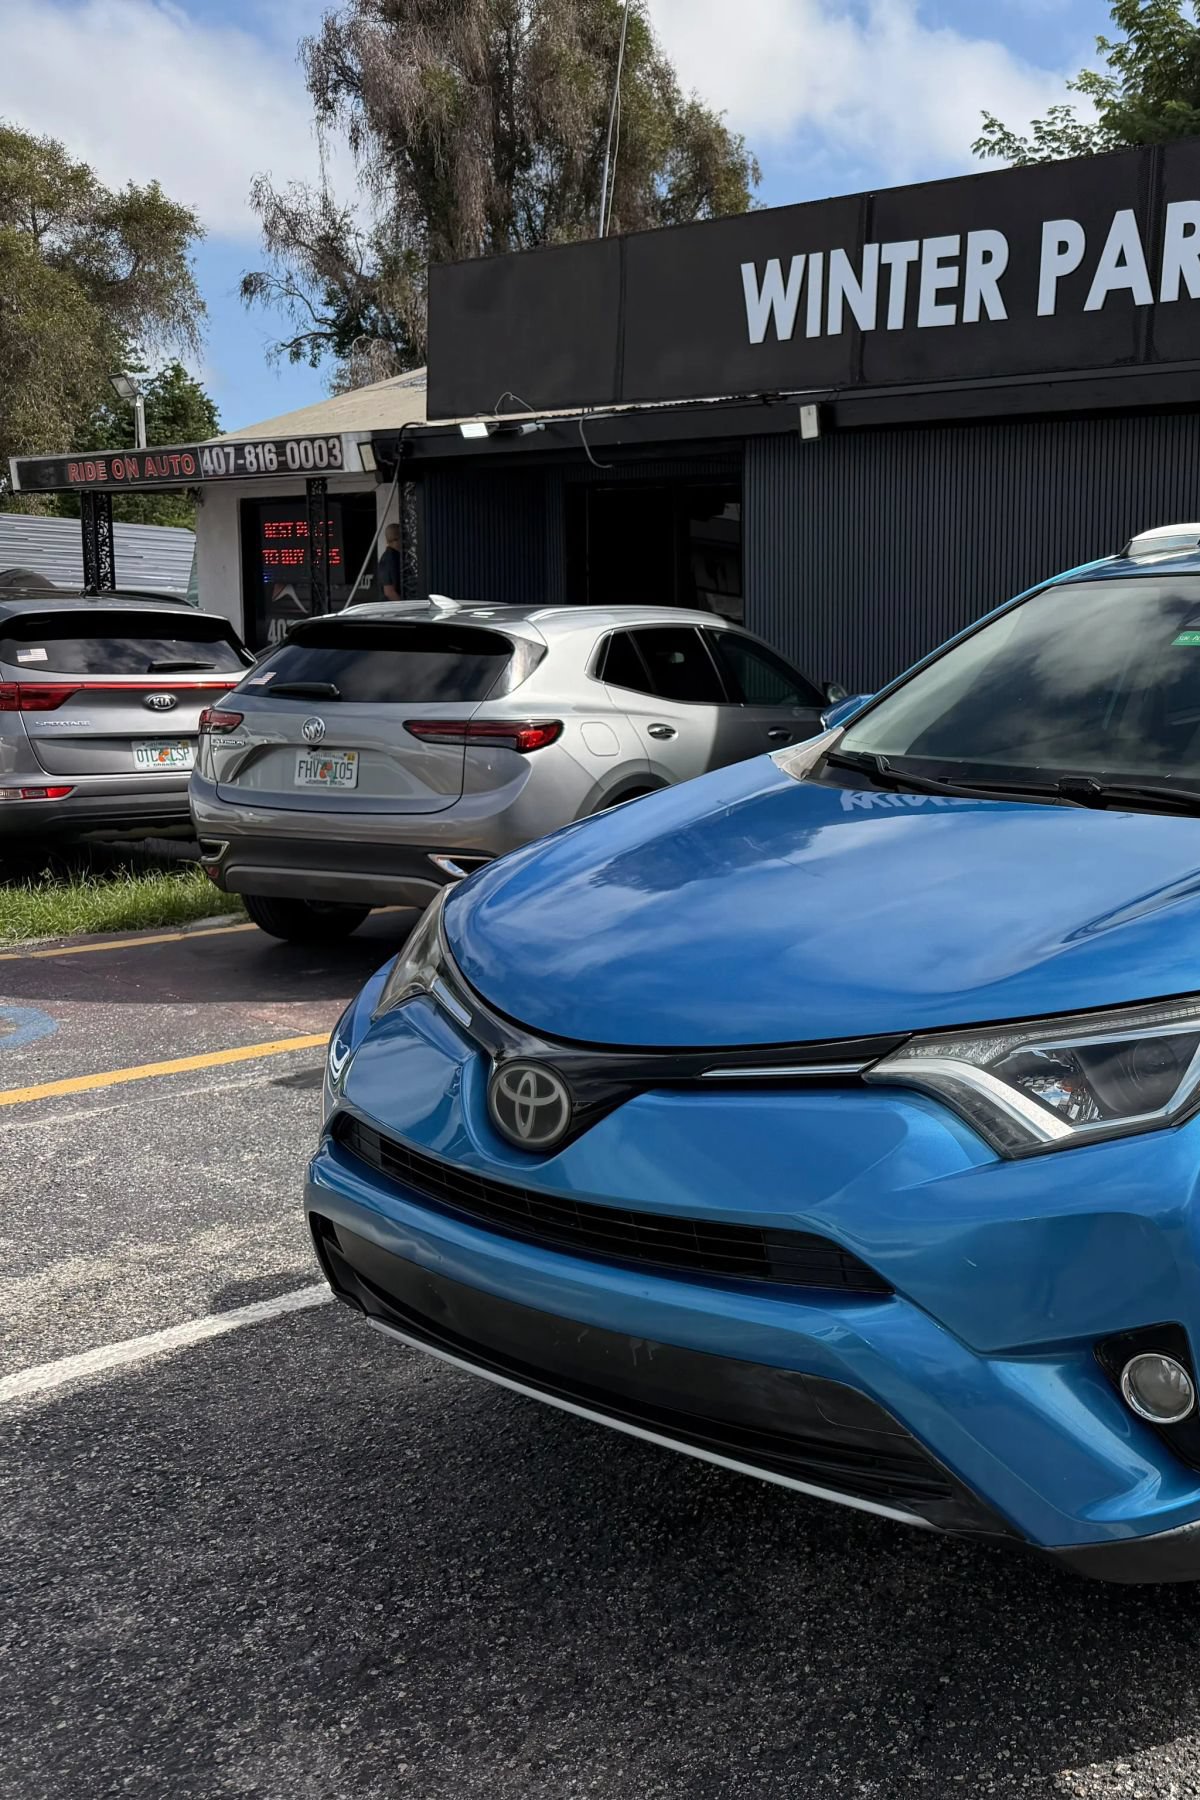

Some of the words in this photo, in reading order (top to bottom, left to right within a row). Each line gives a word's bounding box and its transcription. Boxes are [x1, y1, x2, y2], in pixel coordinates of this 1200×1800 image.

[741, 229, 1009, 344] WINTER
[67, 460, 108, 482] RIDE
[111, 458, 140, 480] ON
[144, 453, 196, 478] AUTO
[202, 437, 343, 476] 407-816-0003
[262, 549, 279, 564] TO
[281, 548, 305, 564] BUY
[153, 696, 171, 706] KIA
[298, 759, 320, 778] FHV
